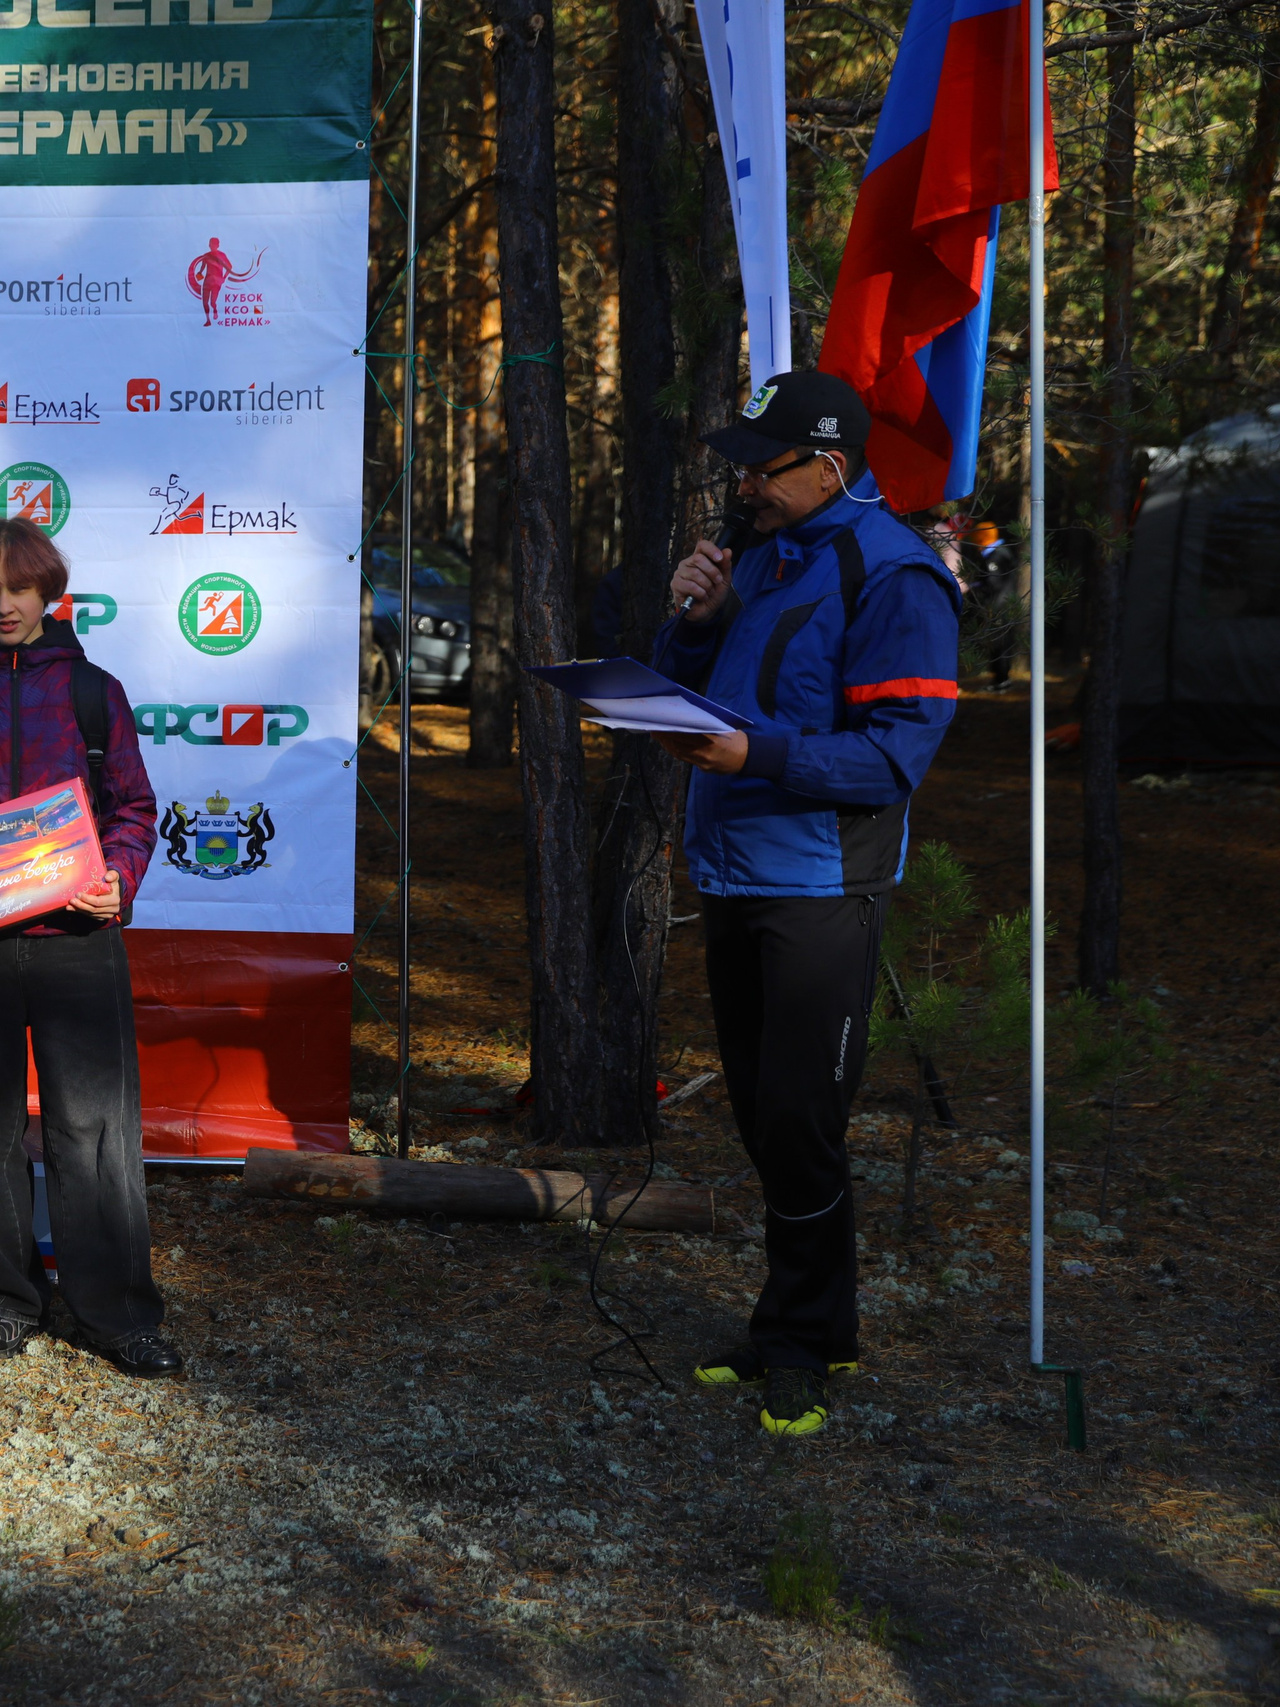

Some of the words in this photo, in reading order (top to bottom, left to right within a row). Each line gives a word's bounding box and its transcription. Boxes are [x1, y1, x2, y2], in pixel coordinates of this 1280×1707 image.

[224, 293, 264, 303] КУБОК
[44, 302, 102, 316] siberia
[224, 305, 250, 315] КСО
[217, 317, 271, 328] «ЕРМАК»
[169, 382, 325, 412] SPORTident
[14, 393, 100, 423] Ермак
[236, 412, 293, 426] siberia
[817, 417, 838, 433] 45
[13, 465, 55, 479] СПОРТИВНОГО
[210, 502, 297, 534] Ермак
[182, 583, 202, 615] ФЕДЕРАЦИЯ
[204, 576, 246, 589] СПОРТИВНОГО
